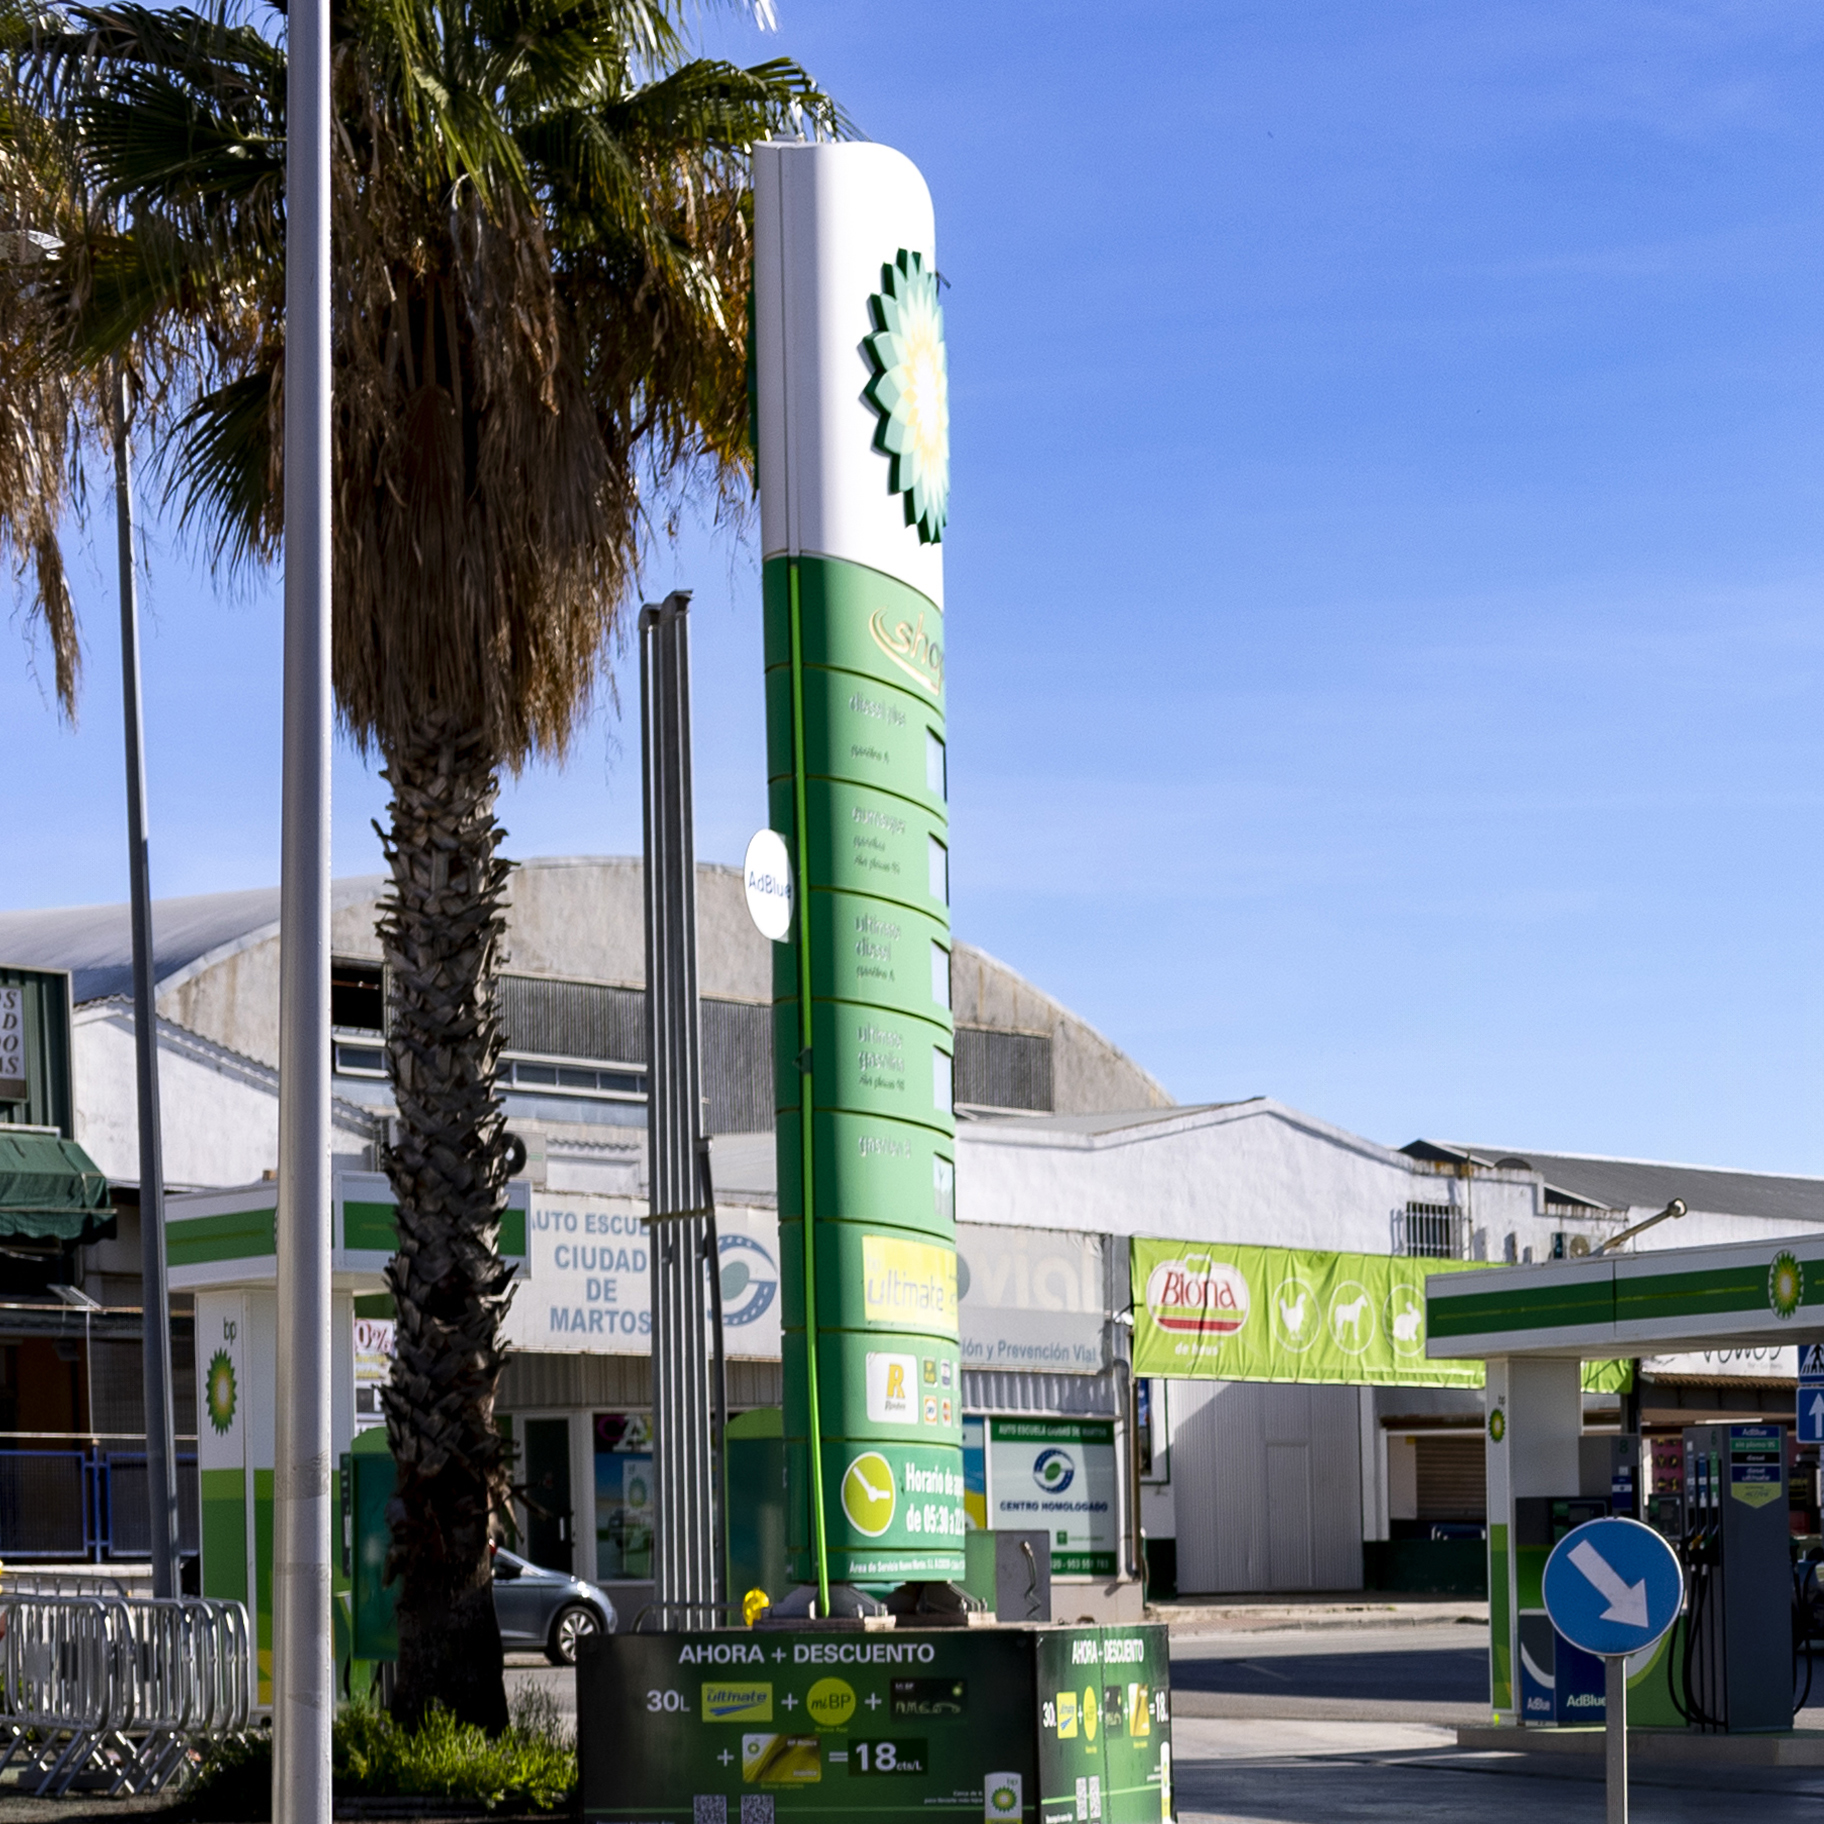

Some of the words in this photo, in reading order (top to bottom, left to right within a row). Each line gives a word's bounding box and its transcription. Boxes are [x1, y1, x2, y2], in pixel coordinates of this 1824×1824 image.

[748, 870, 792, 897] AdBlue
[554, 1243, 648, 1273] CIUDAD
[586, 1278, 617, 1303] DE
[867, 1269, 945, 1312] ultimate
[1160, 1271, 1238, 1309] Biona
[550, 1306, 651, 1335] MARTOS
[998, 1339, 1069, 1361] Prevención
[1073, 1343, 1097, 1362] Vial
[905, 1462, 944, 1495] Horario
[906, 1503, 922, 1533] de
[1000, 1501, 1039, 1512] CENTRO
[1041, 1501, 1109, 1512] HOMOLOGADO
[678, 1644, 765, 1664] AHORA
[793, 1643, 936, 1664] DESCUENTO
[1072, 1640, 1098, 1665] AHORA
[1103, 1639, 1144, 1664] DESCUENTO
[646, 1689, 691, 1713] 30L
[707, 1688, 767, 1703] ultimate
